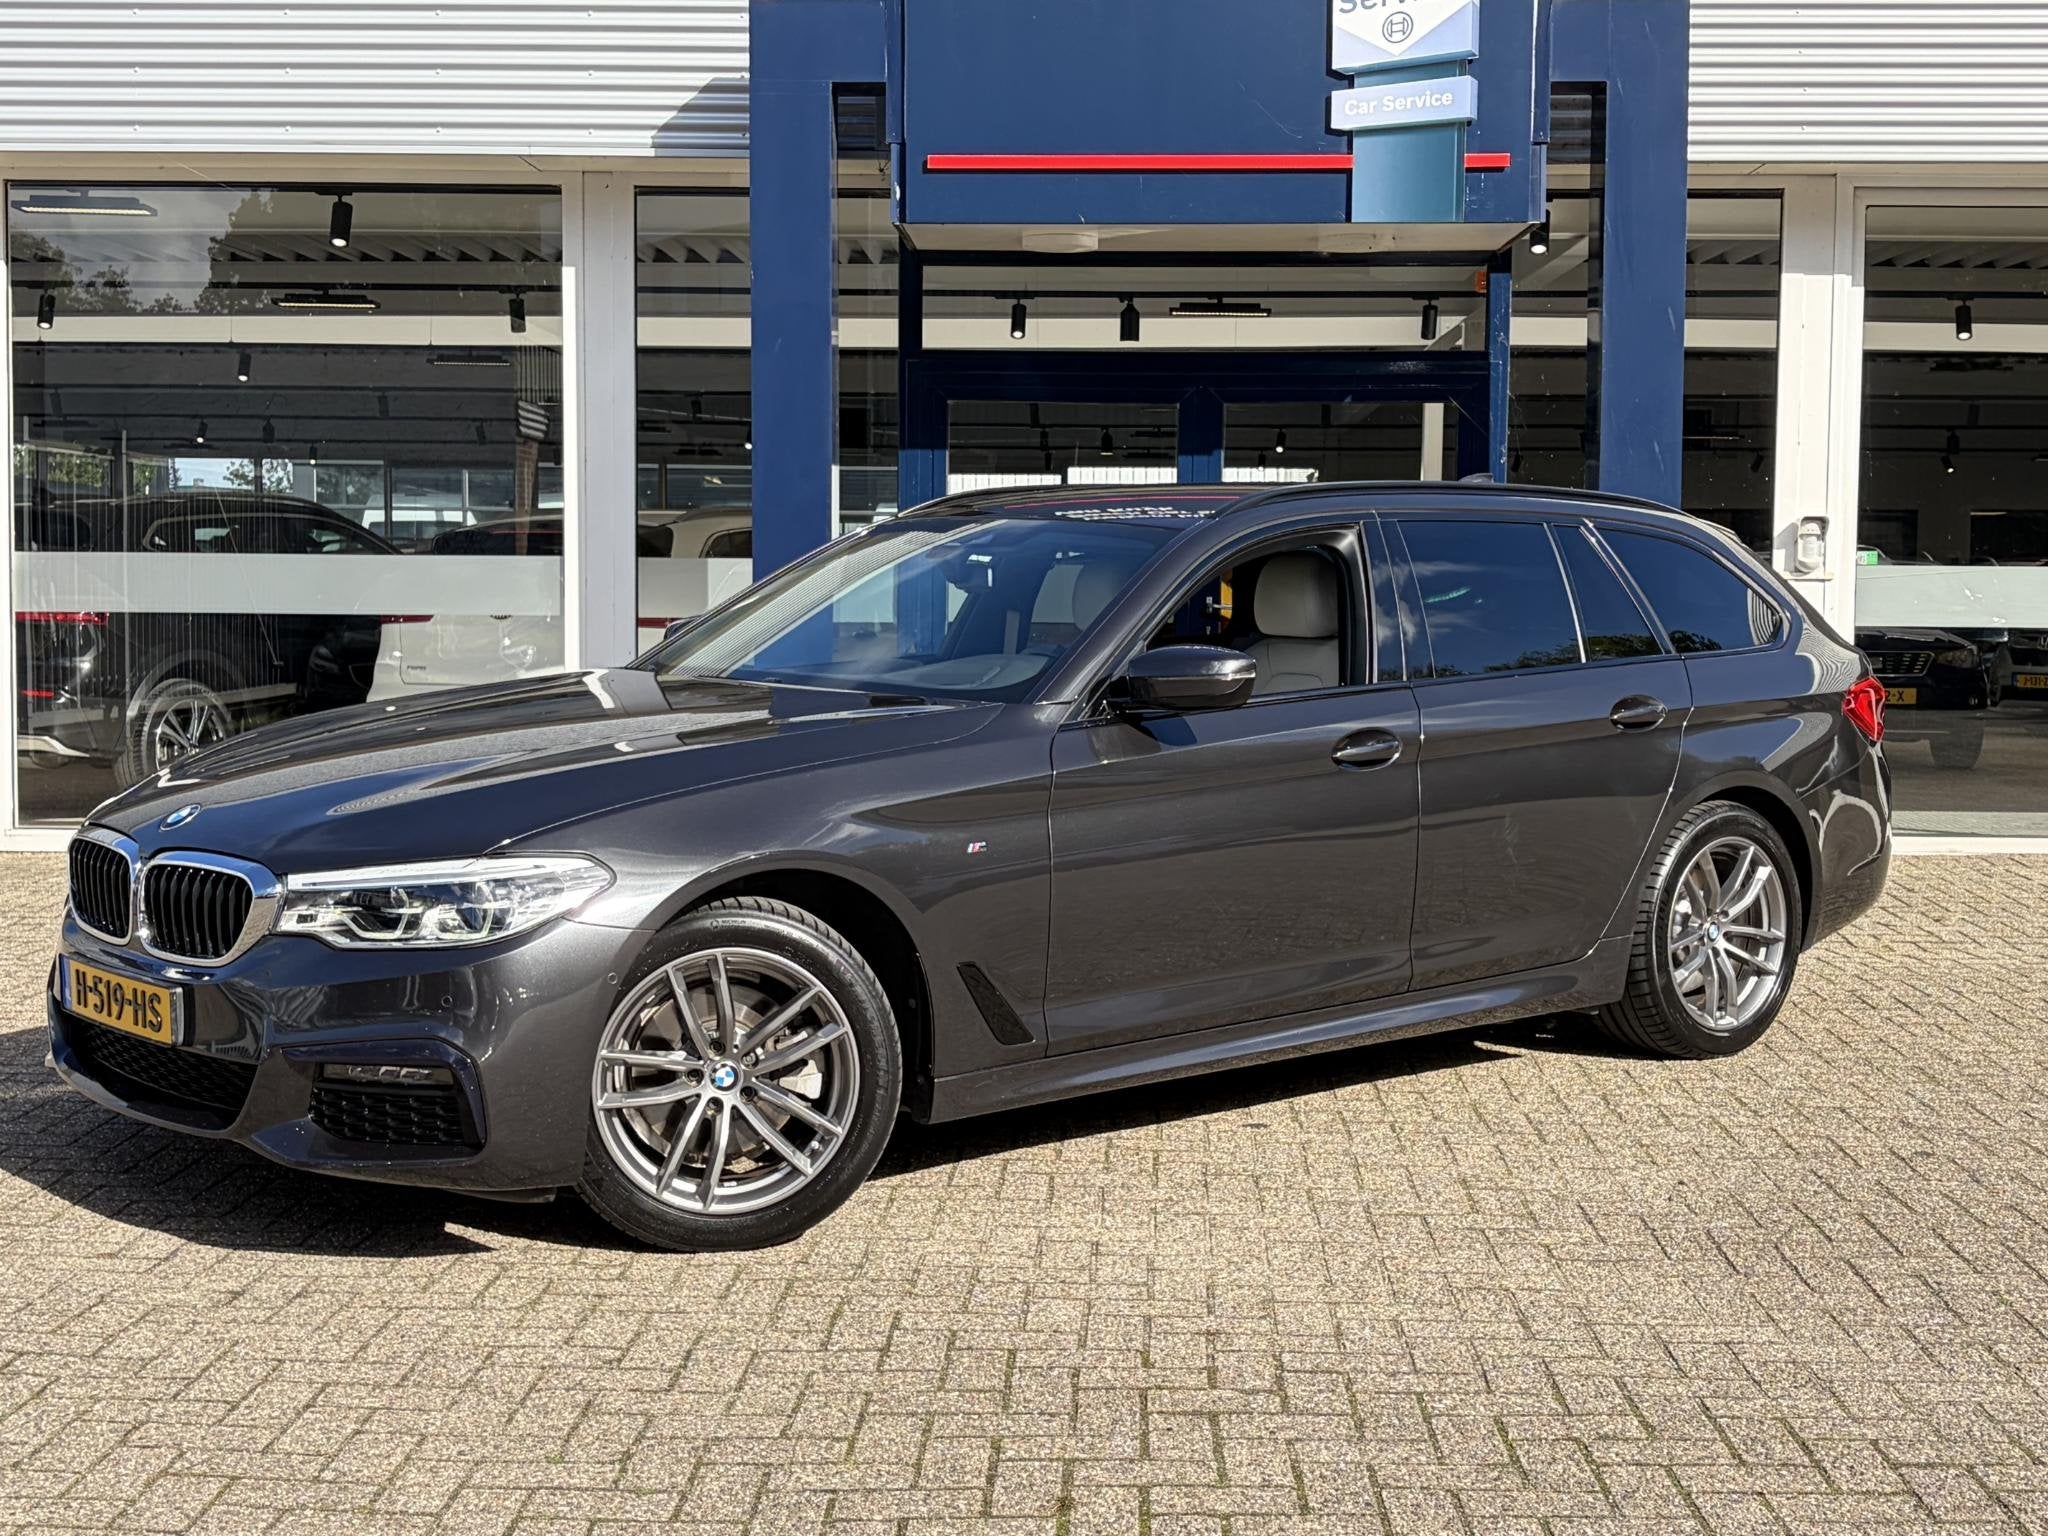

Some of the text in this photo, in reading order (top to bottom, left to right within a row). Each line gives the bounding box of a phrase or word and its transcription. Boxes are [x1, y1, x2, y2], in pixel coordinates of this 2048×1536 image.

[1344, 90, 1454, 116] Car Service
[74, 968, 163, 1033] H-519-HS
